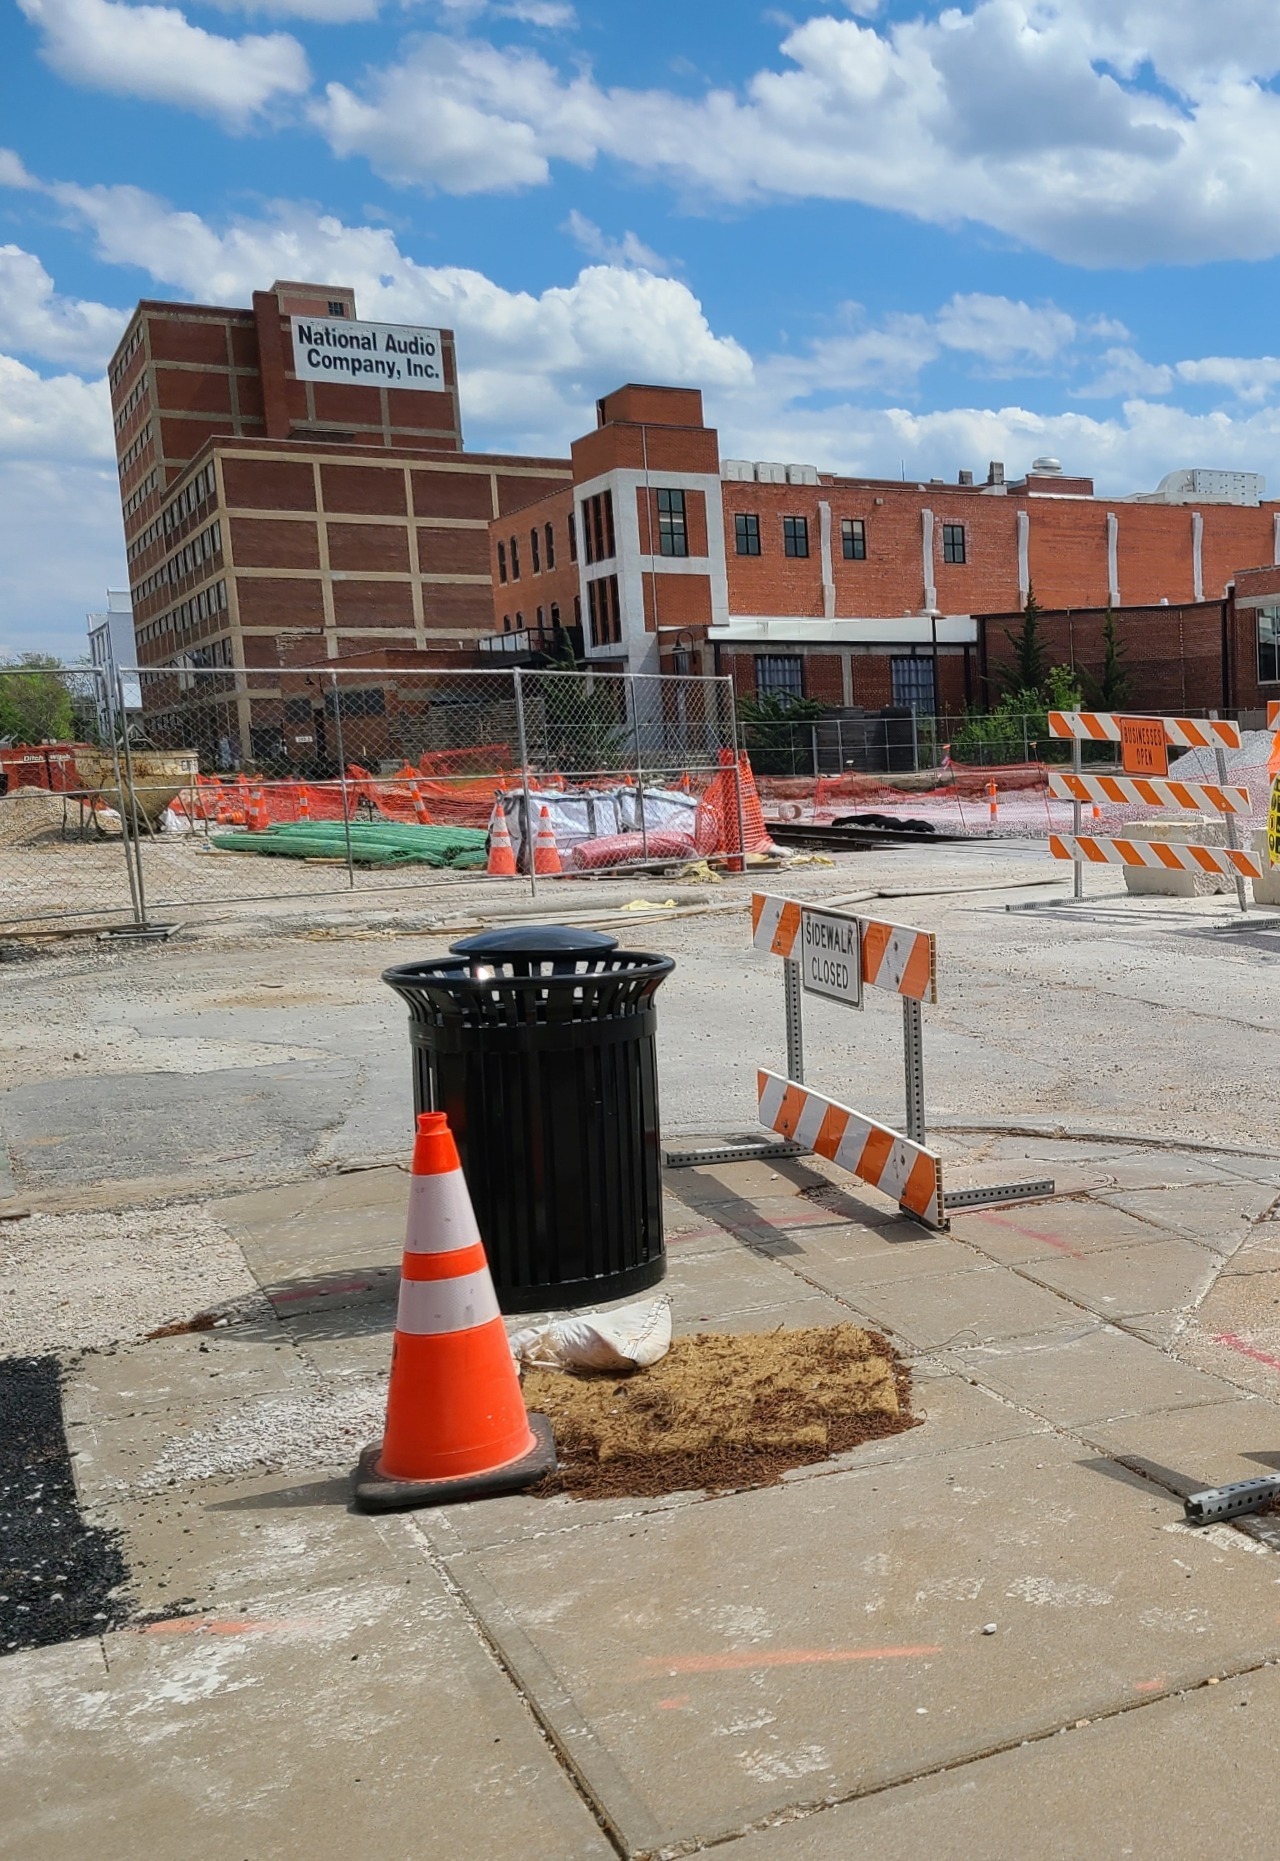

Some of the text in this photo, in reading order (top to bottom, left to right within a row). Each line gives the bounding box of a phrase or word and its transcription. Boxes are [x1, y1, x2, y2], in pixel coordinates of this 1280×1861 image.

[298, 325, 436, 356] National Audio
[307, 348, 440, 379] Company, Inc.
[1123, 727, 1162, 746] BUSINESSES
[1136, 748, 1153, 766] OPEN
[806, 921, 854, 955] SIDEWALK
[812, 957, 849, 989] CLOSED
